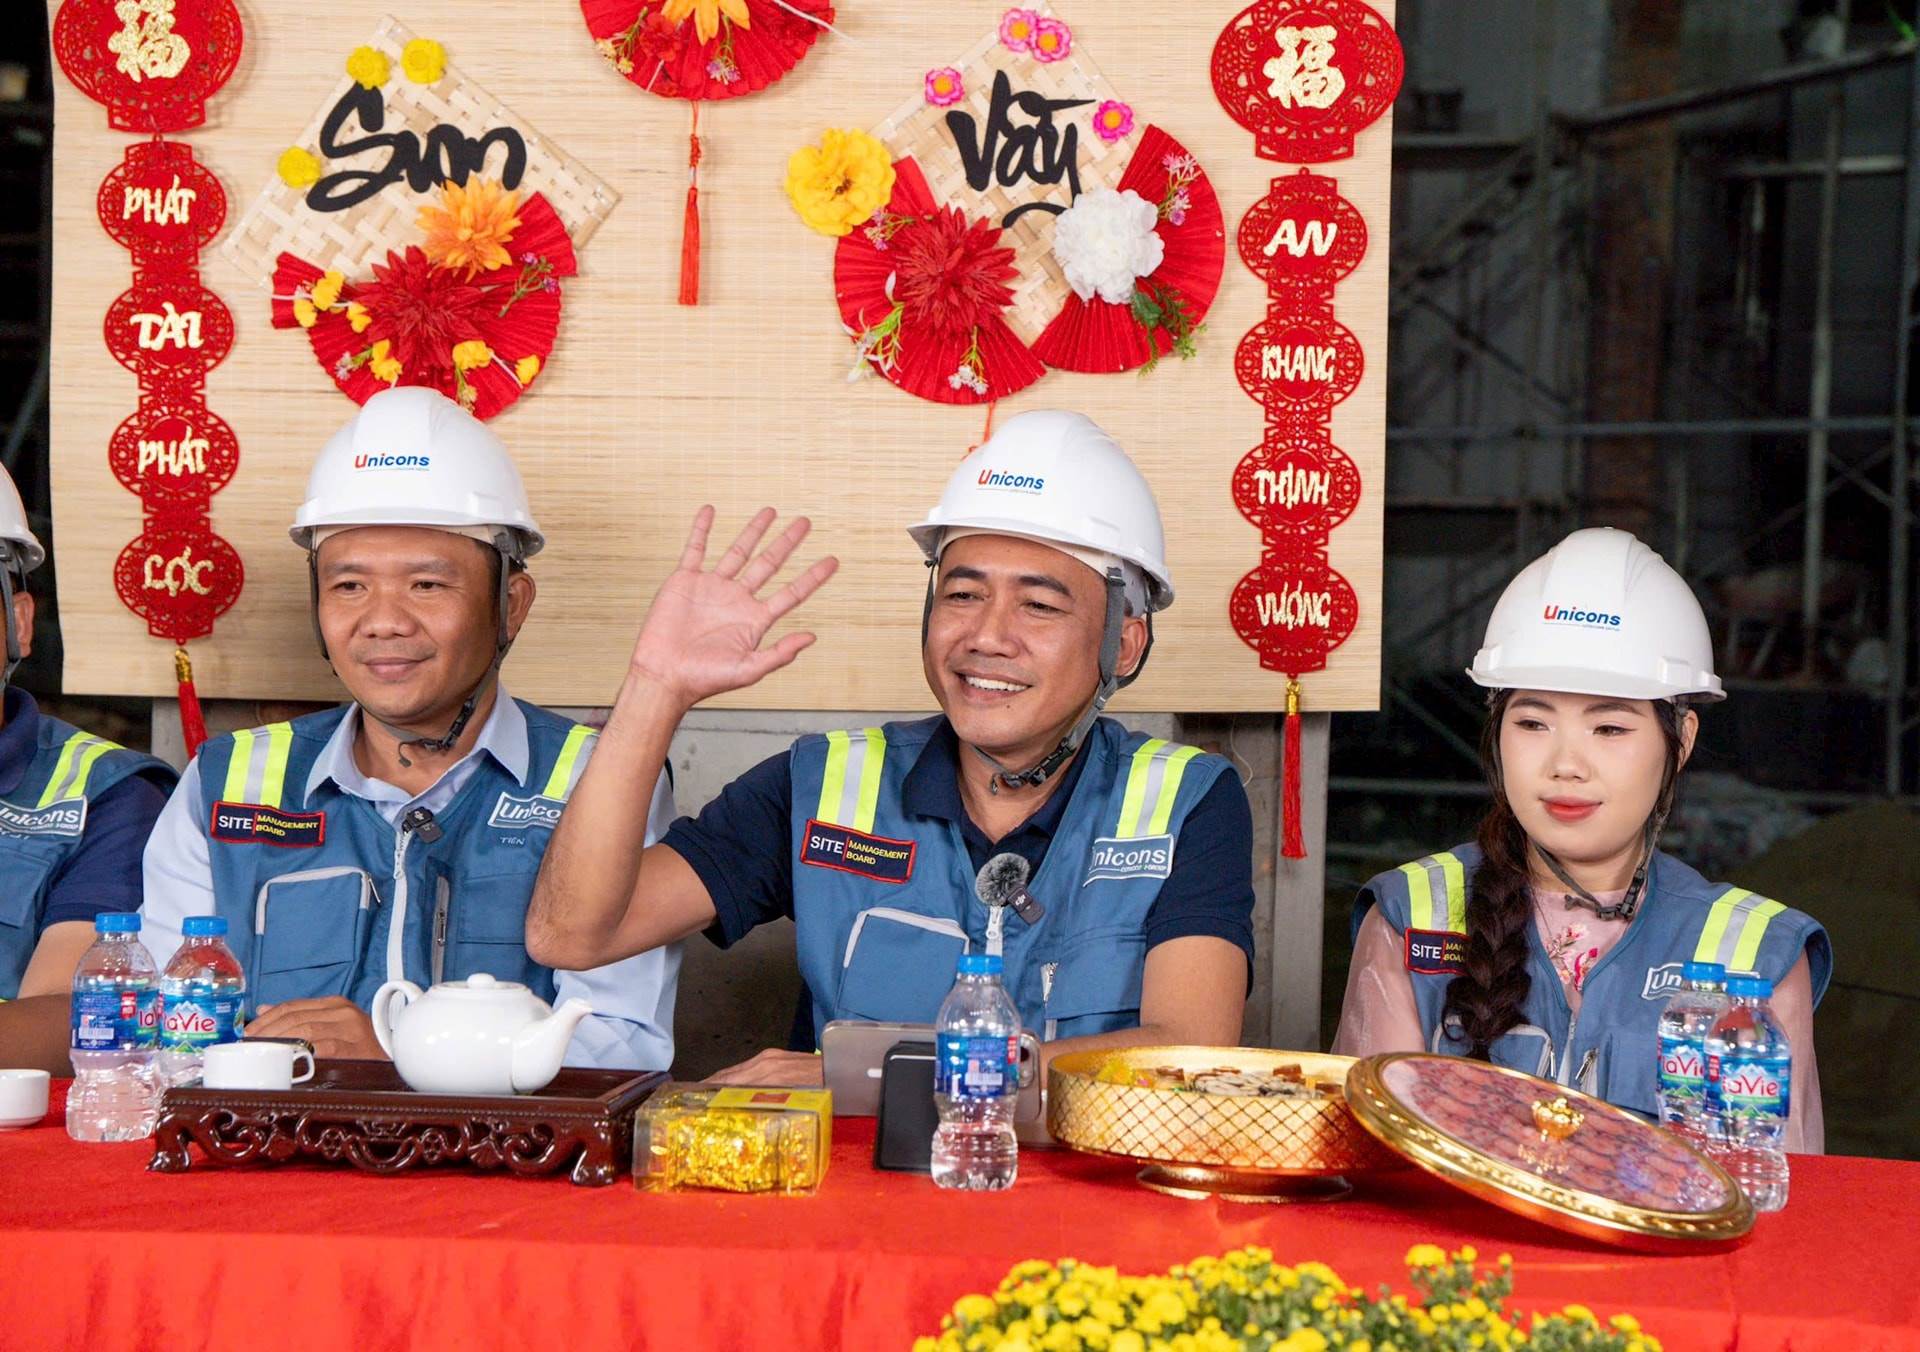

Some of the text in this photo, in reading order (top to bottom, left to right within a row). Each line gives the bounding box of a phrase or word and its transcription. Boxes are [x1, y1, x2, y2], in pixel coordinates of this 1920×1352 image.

[1262, 24, 1346, 109] 福
[122, 173, 197, 227] PHÁT
[1262, 218, 1338, 258] AN
[129, 301, 205, 352] TÀI
[1261, 344, 1337, 383] KHANG
[137, 425, 211, 477] PHÁT
[354, 452, 430, 468] Unicons
[977, 469, 1045, 490] Unicons
[1251, 461, 1332, 510] THỊNH
[1543, 605, 1621, 626] Unicons
[256, 814, 319, 829] MANAGEMENT
[499, 802, 562, 820] Unico
[218, 815, 254, 830] SITE
[255, 824, 286, 836] BOARD
[810, 835, 845, 855] SITE
[848, 840, 909, 860] MANAGEMENT
[846, 851, 876, 865] BOARD
[1411, 943, 1442, 960] SITE
[1722, 1074, 1779, 1096] laVie
